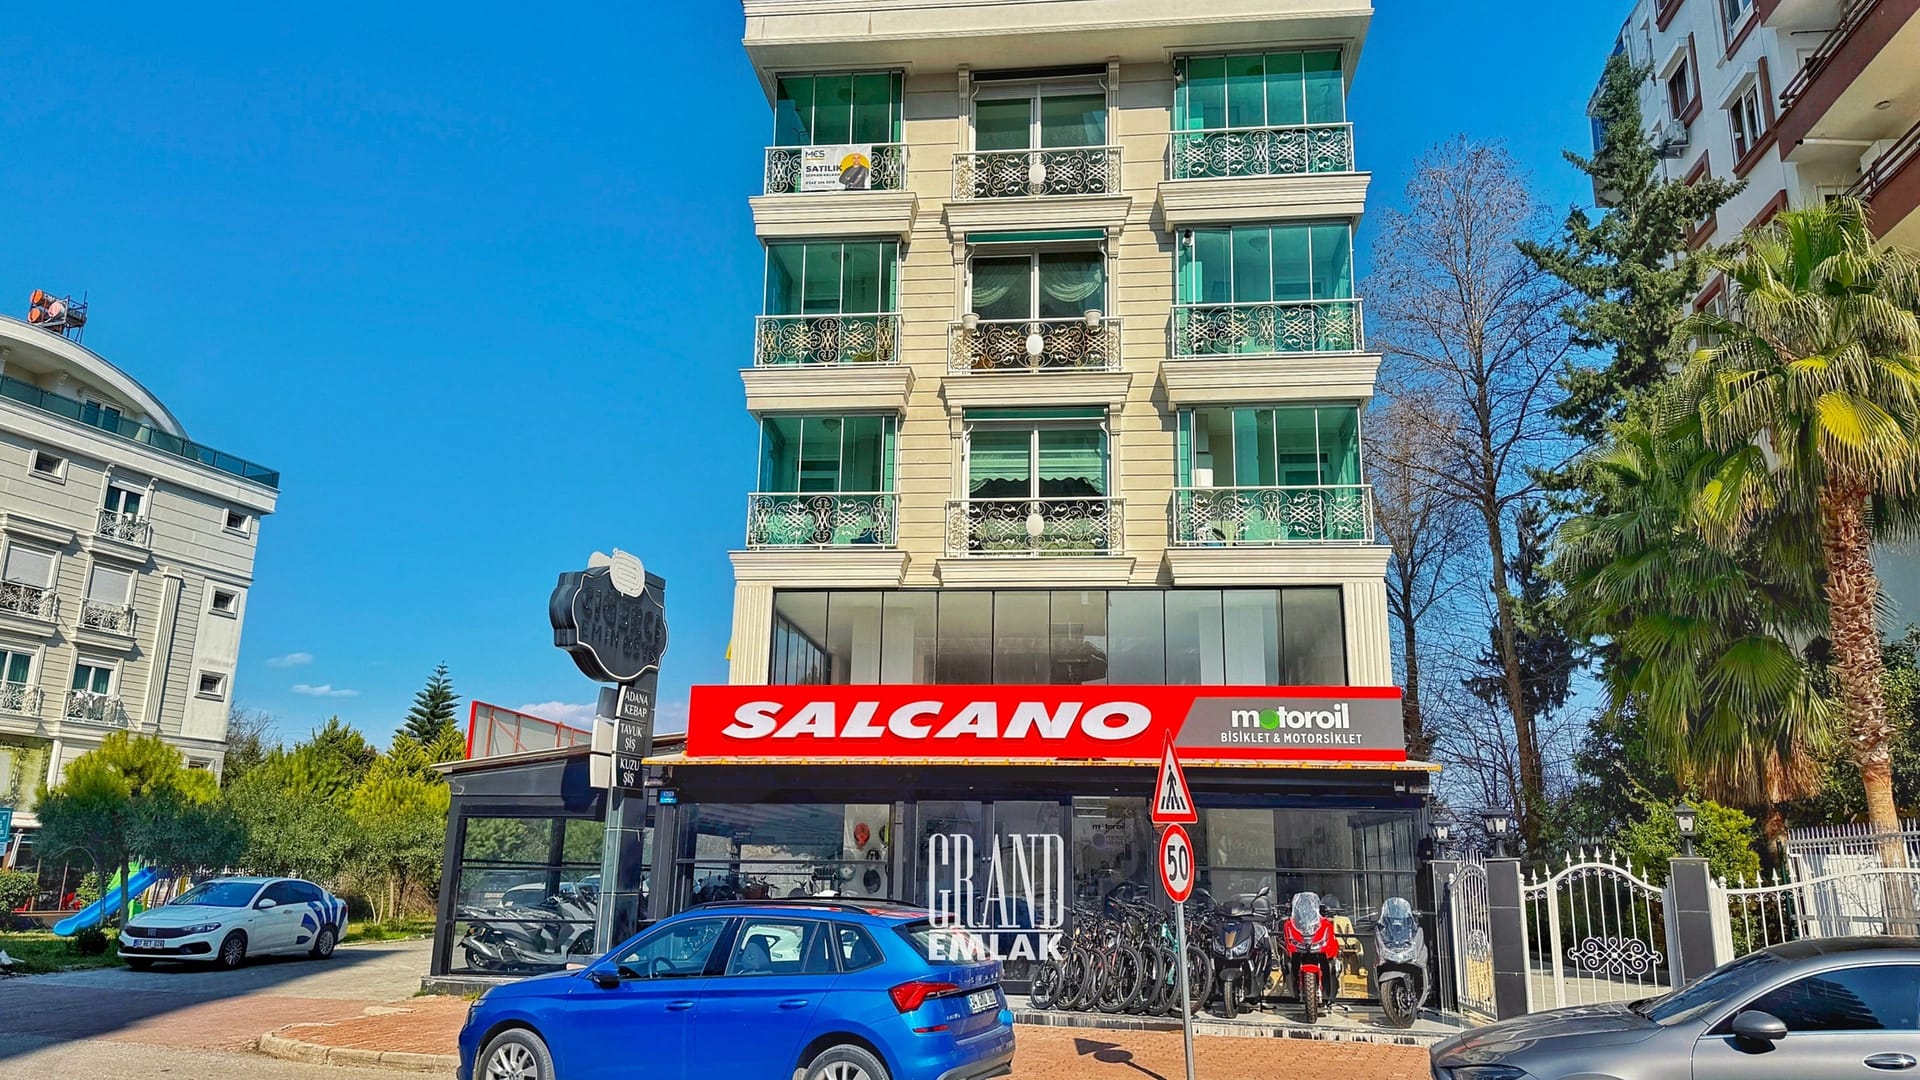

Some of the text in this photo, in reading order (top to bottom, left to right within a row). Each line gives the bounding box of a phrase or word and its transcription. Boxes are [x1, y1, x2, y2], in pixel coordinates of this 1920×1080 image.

[806, 165, 842, 173] SATILIK
[625, 691, 648, 705] ADANA
[624, 703, 648, 717] KEBAP
[1231, 702, 1350, 730] motoroil
[722, 700, 1153, 741] SALCANO
[620, 723, 643, 738] TAVUK
[1220, 730, 1363, 744] BİSİKLET & MOTORSİKLET
[624, 736, 637, 752] ŞİŞ
[620, 757, 640, 771] KUZU
[623, 770, 635, 786] ŞİŞ
[1167, 844, 1189, 882] 50
